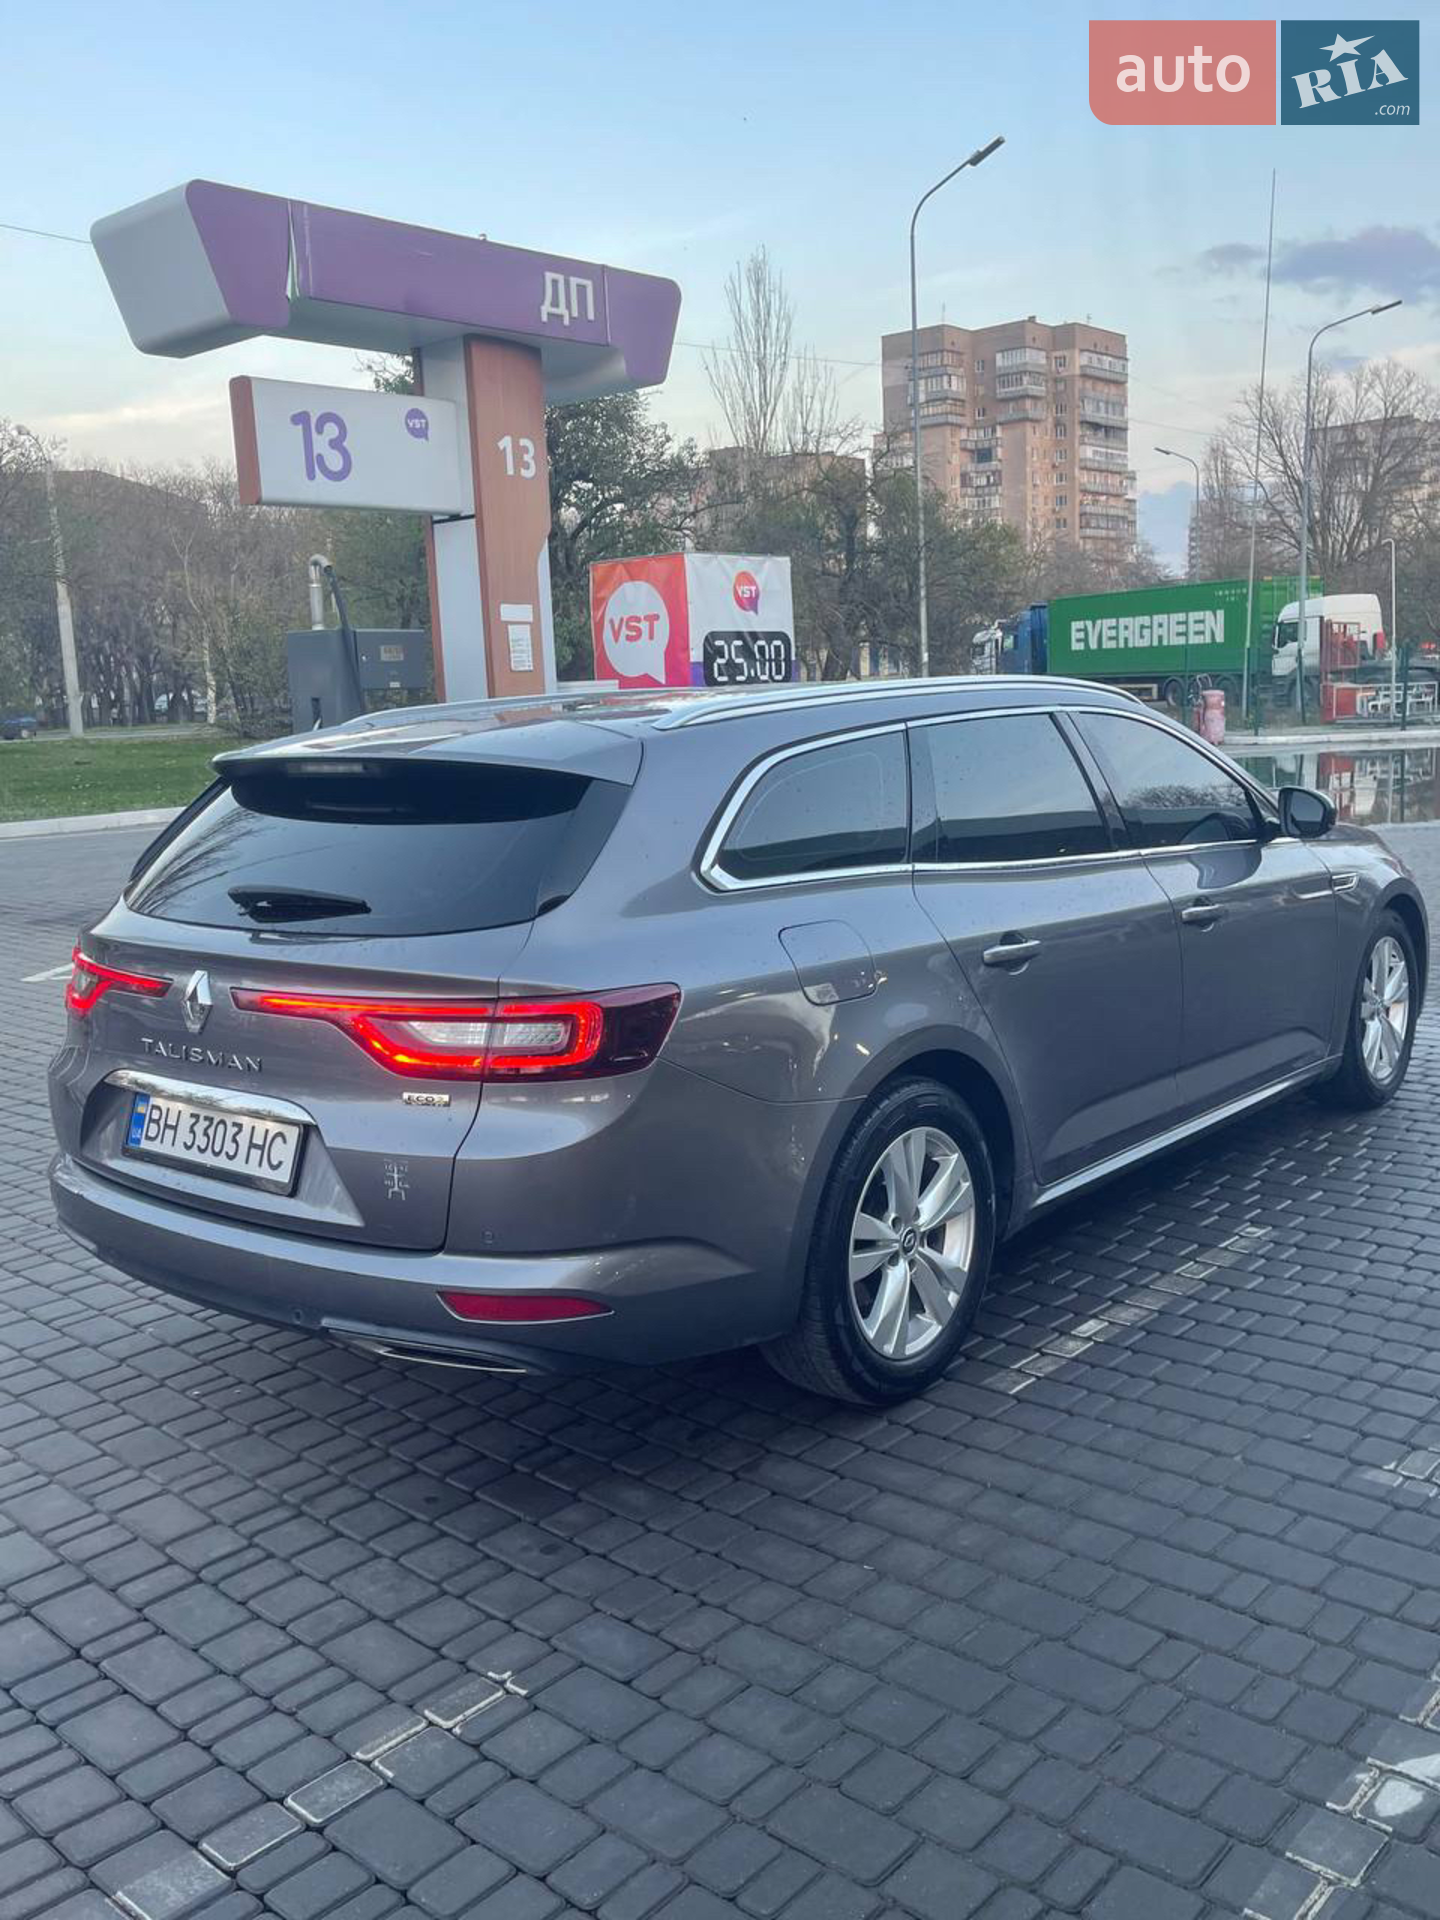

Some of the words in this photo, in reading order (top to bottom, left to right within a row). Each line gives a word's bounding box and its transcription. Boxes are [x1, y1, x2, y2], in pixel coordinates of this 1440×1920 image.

[540, 271, 594, 326] ДП
[407, 418, 427, 428] VST
[290, 410, 352, 482] 13
[497, 435, 537, 479] 13
[737, 585, 757, 598] VST
[609, 613, 661, 644] VST
[1071, 609, 1225, 651] EVERGREEN
[713, 640, 786, 682] 25.00
[141, 1037, 262, 1072] TALISMAN
[144, 1104, 182, 1147] BH
[183, 1112, 244, 1161] 3303
[245, 1125, 288, 1171] HC
